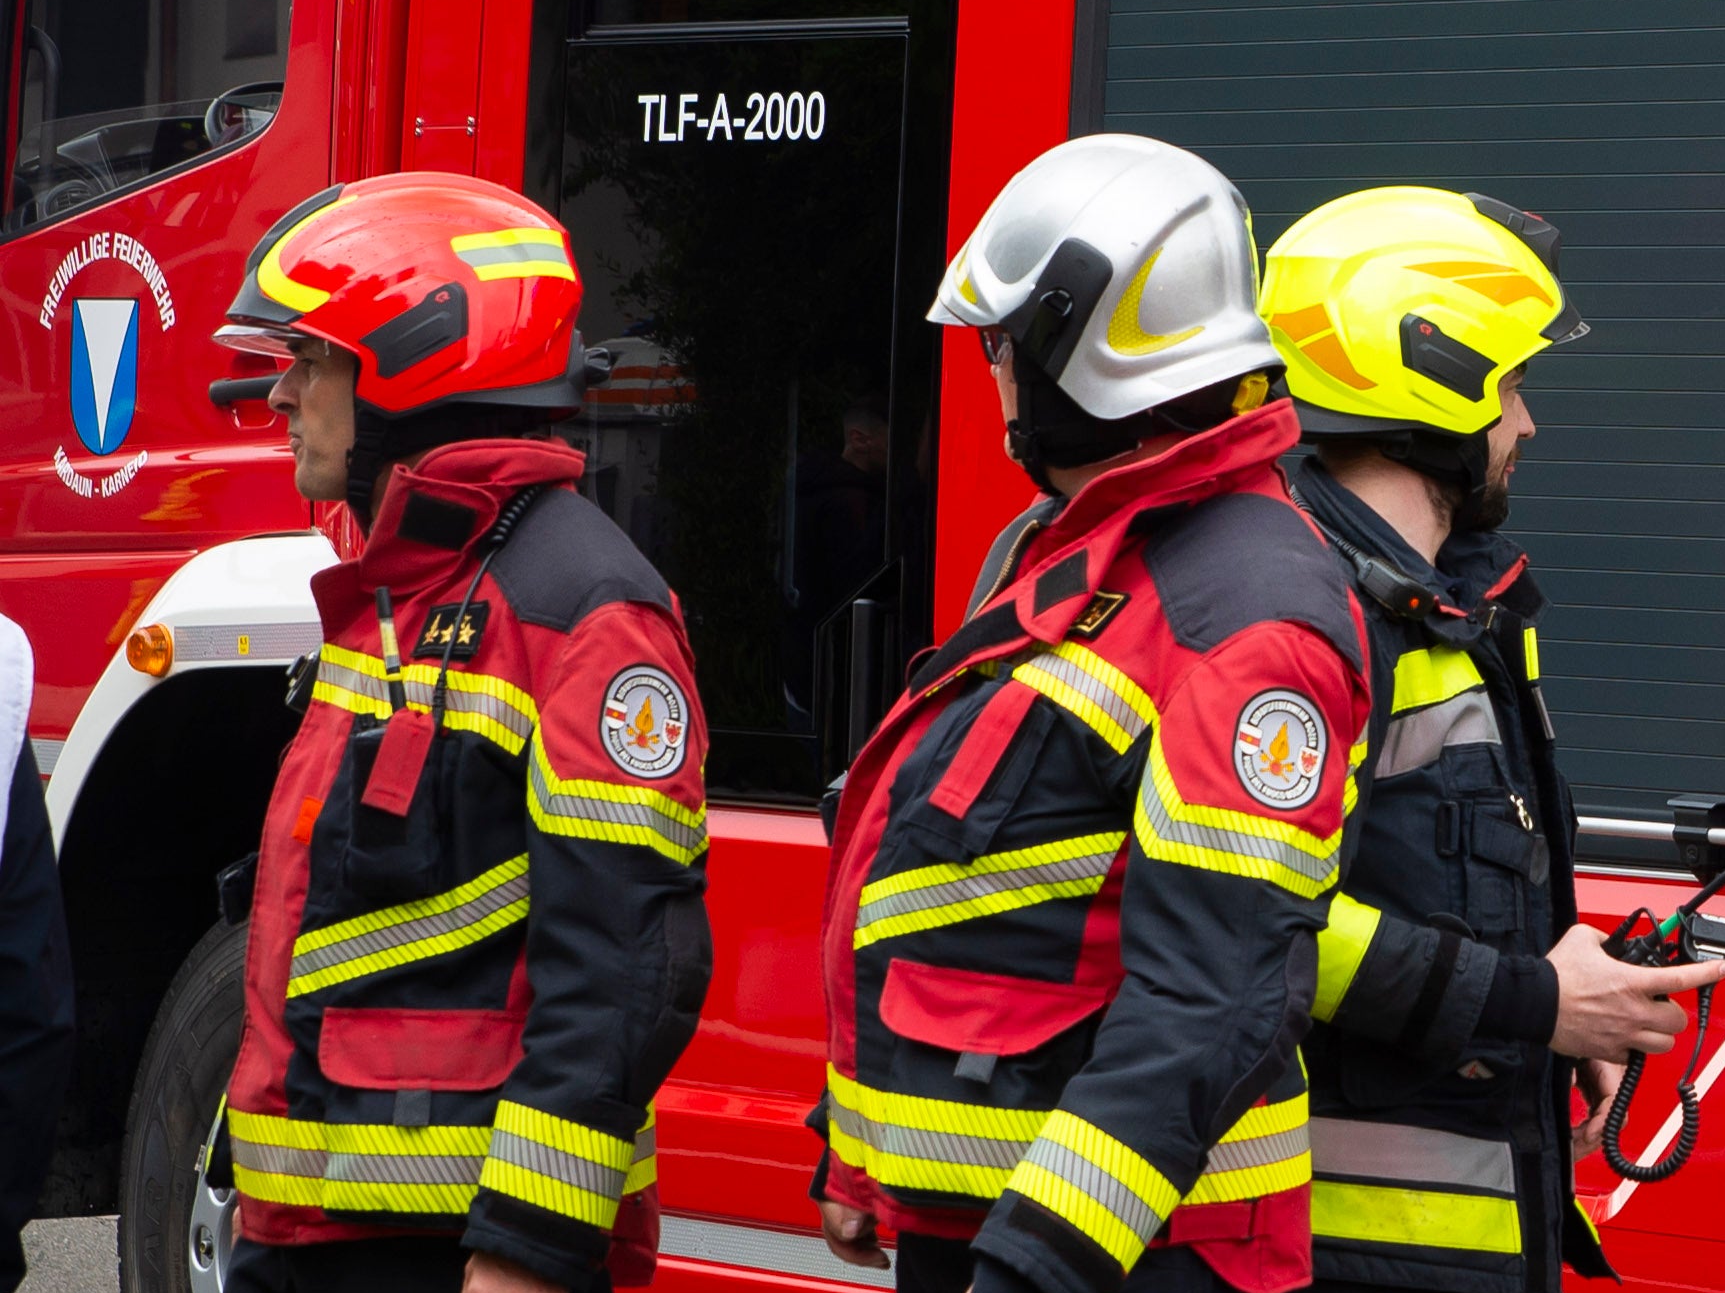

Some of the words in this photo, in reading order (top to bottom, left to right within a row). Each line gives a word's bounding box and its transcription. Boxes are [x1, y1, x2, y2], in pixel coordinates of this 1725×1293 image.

[638, 91, 825, 142] TLF-A-2000
[40, 232, 110, 330] FREIWILLIGE
[113, 233, 176, 331] FEUERWEHR
[54, 445, 92, 498] KARDAUN
[101, 450, 148, 497] KARNEID
